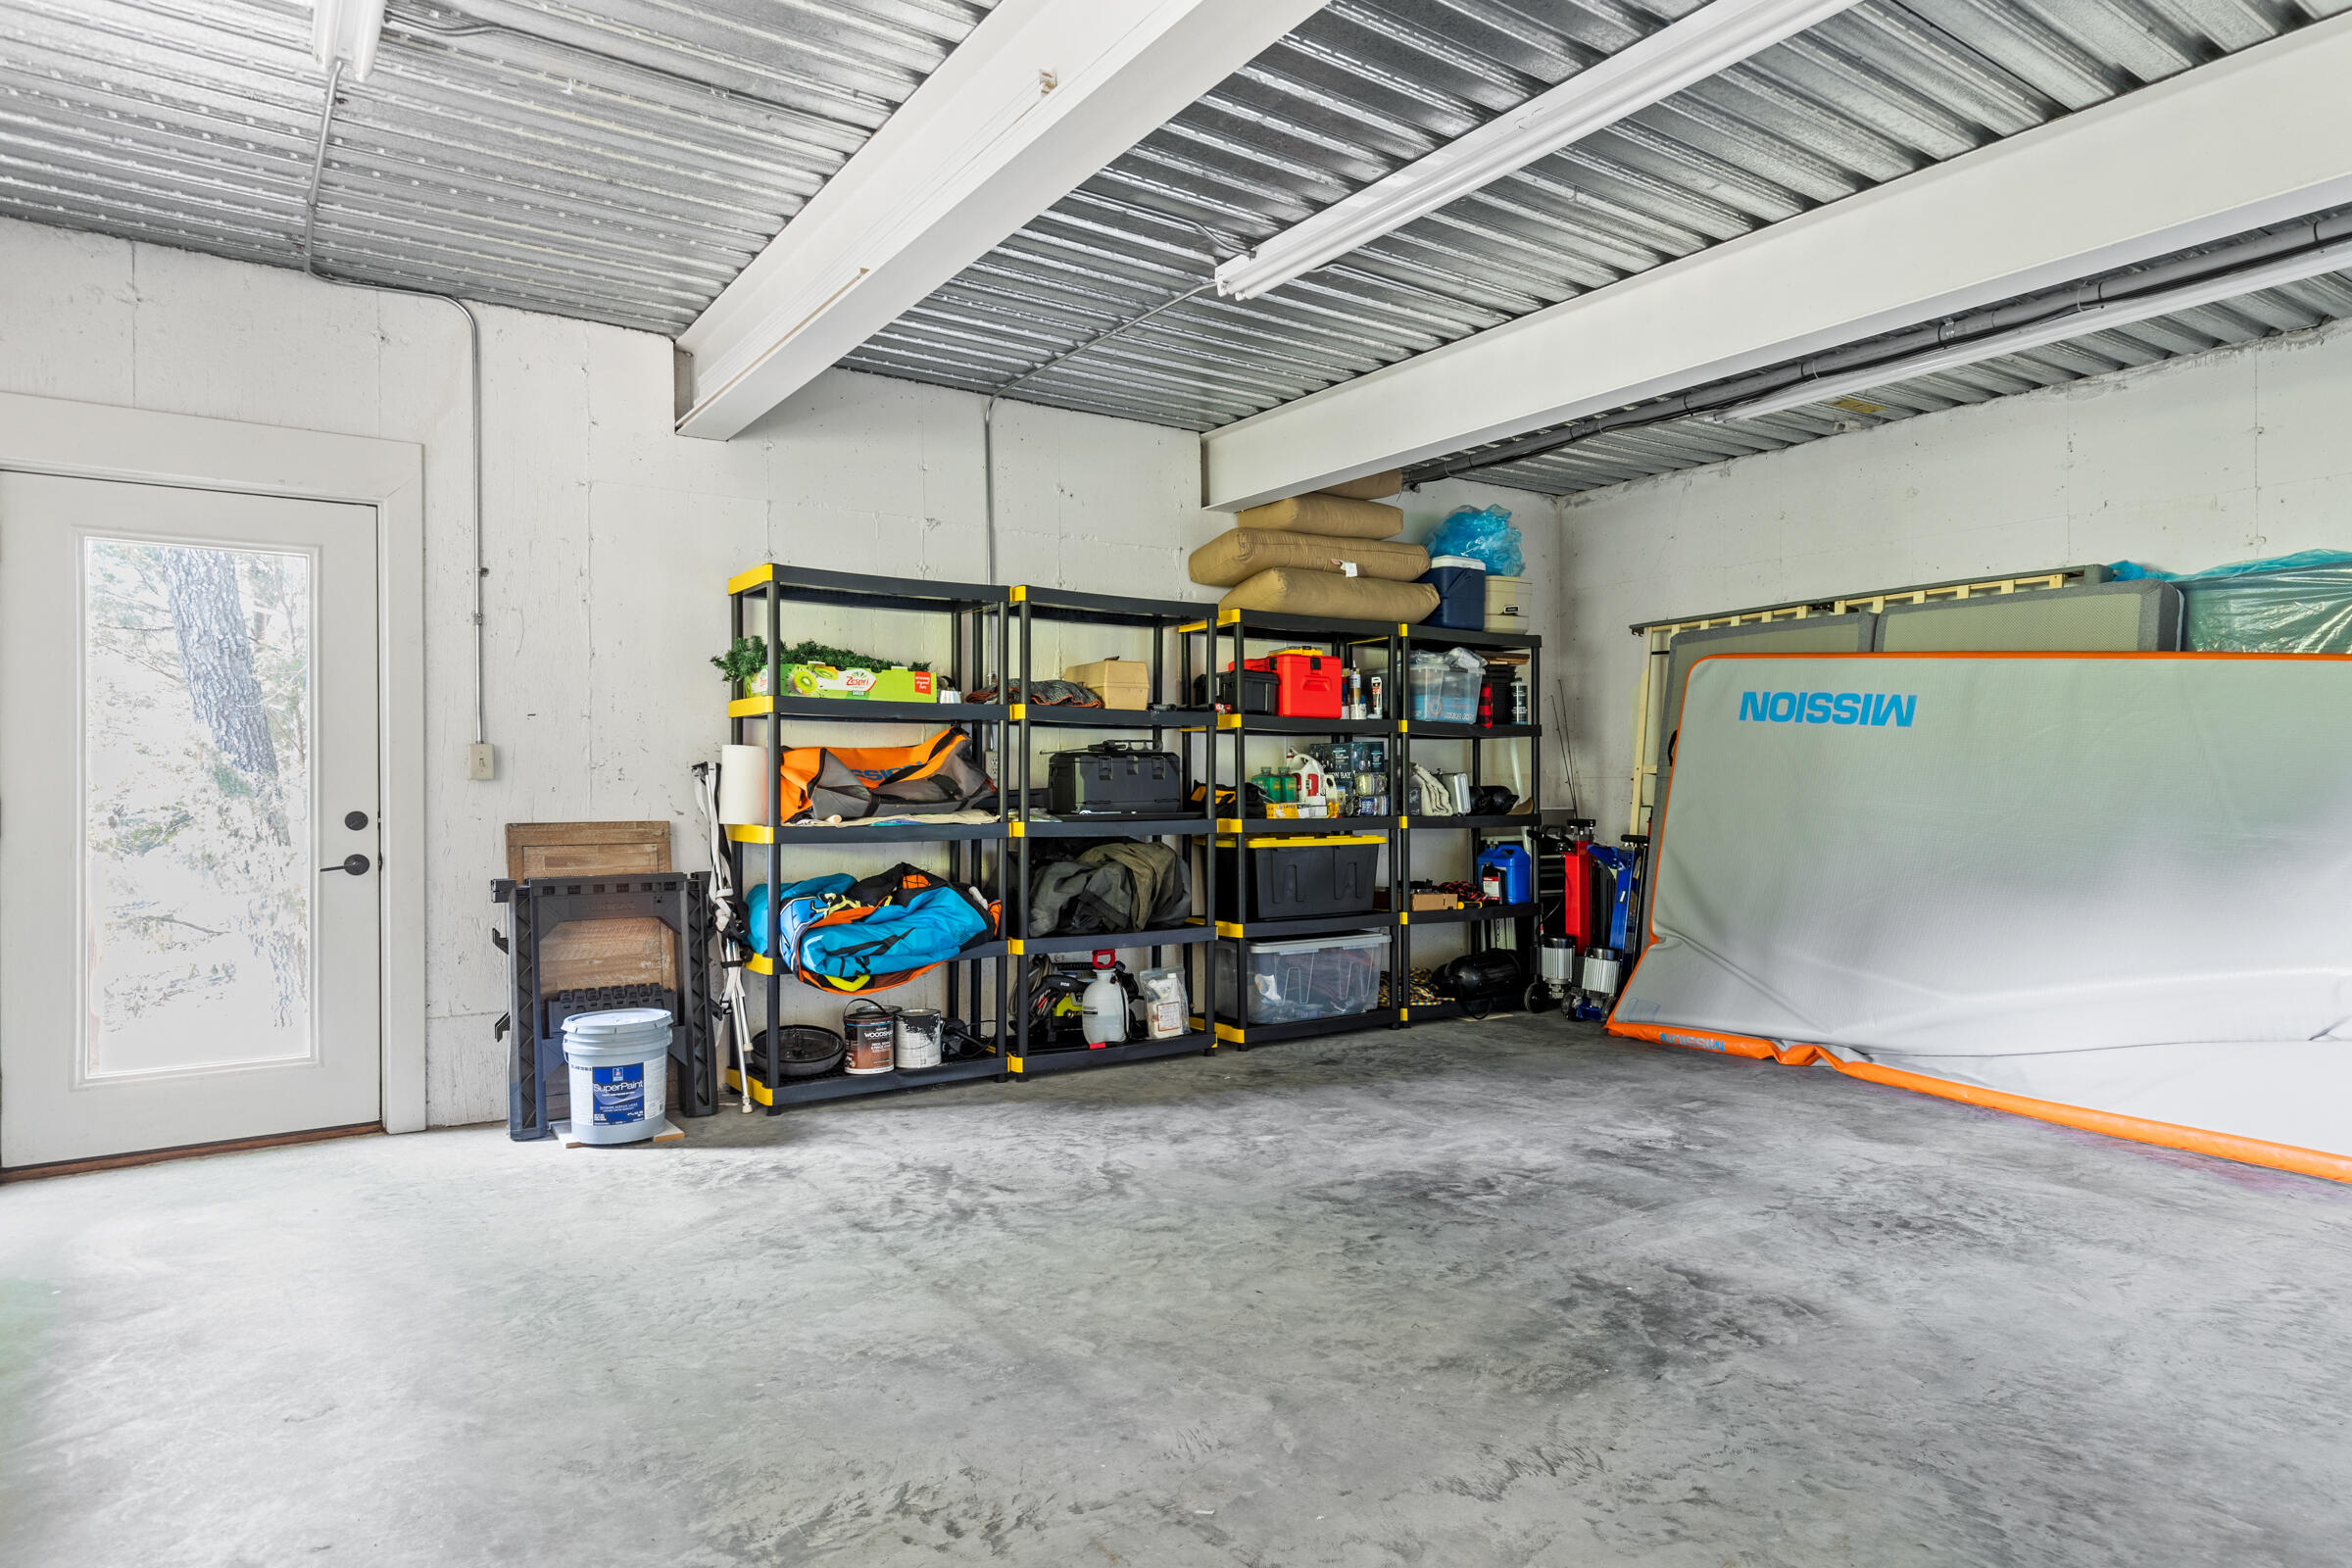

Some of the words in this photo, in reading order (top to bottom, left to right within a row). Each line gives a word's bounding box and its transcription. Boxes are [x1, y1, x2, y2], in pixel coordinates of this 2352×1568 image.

[846, 675, 869, 686] Zespri
[1739, 691, 1918, 727] MISSION
[1660, 1032, 1725, 1053] MISSION
[593, 1080, 643, 1093] SuperPaint
